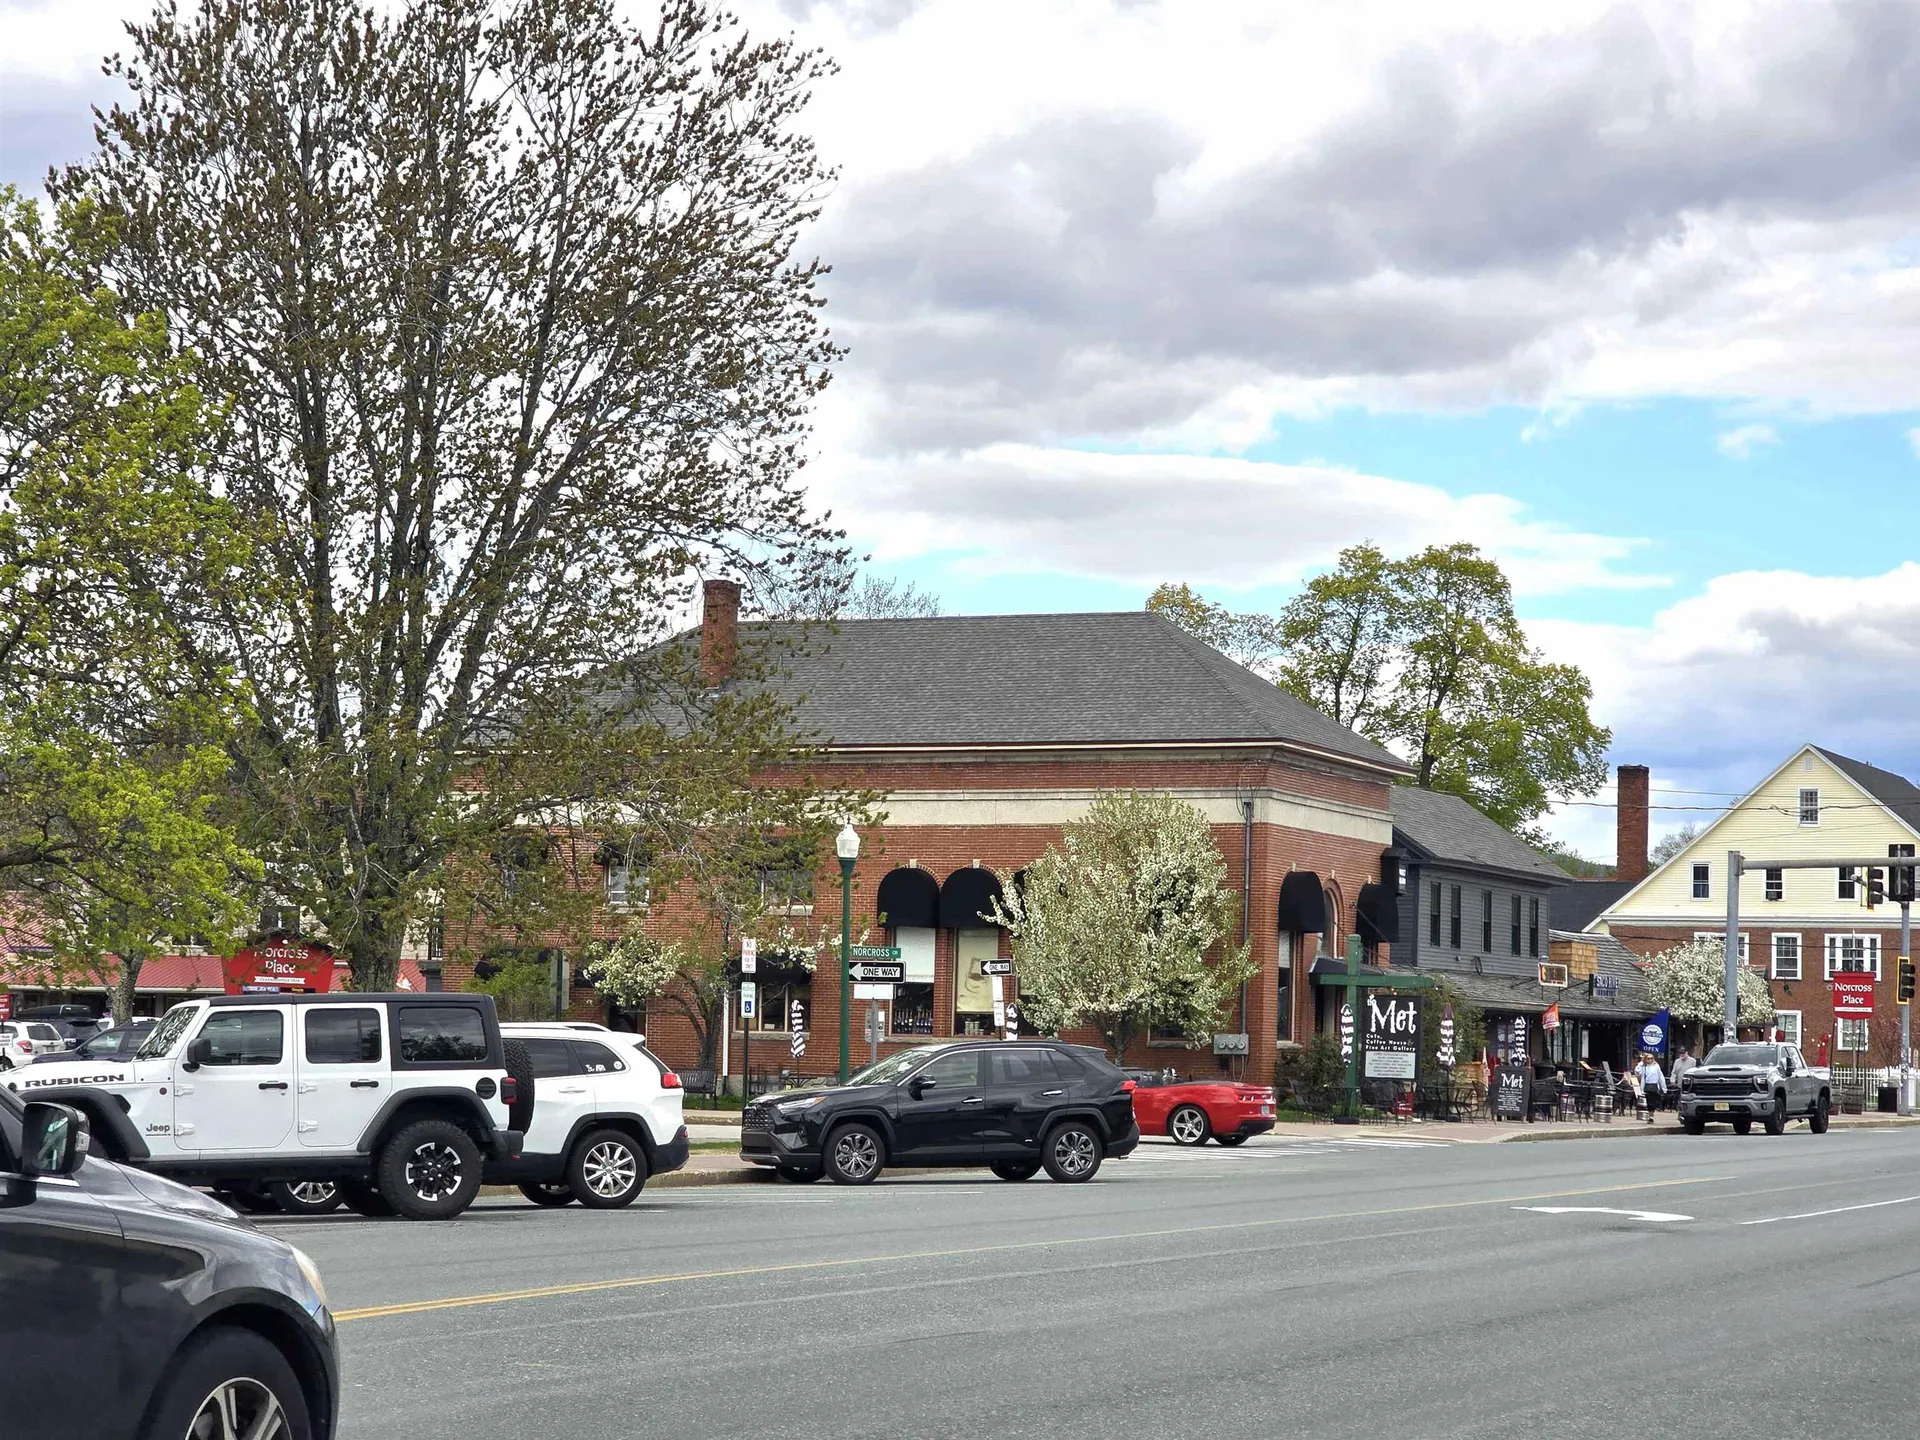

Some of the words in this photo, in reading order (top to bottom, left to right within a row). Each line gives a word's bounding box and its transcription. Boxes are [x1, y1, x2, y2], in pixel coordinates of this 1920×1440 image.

[254, 947, 309, 959] orcross
[853, 948, 890, 957] NORCROSS
[863, 967, 880, 976] ONE
[881, 967, 898, 976] WAY
[1835, 983, 1872, 992] Norcross
[1842, 994, 1864, 1004] Place
[1370, 1000, 1418, 1034] Met
[25, 1074, 124, 1088] RUBICON
[1501, 1073, 1524, 1088] Met
[146, 1123, 170, 1133] Jeep
